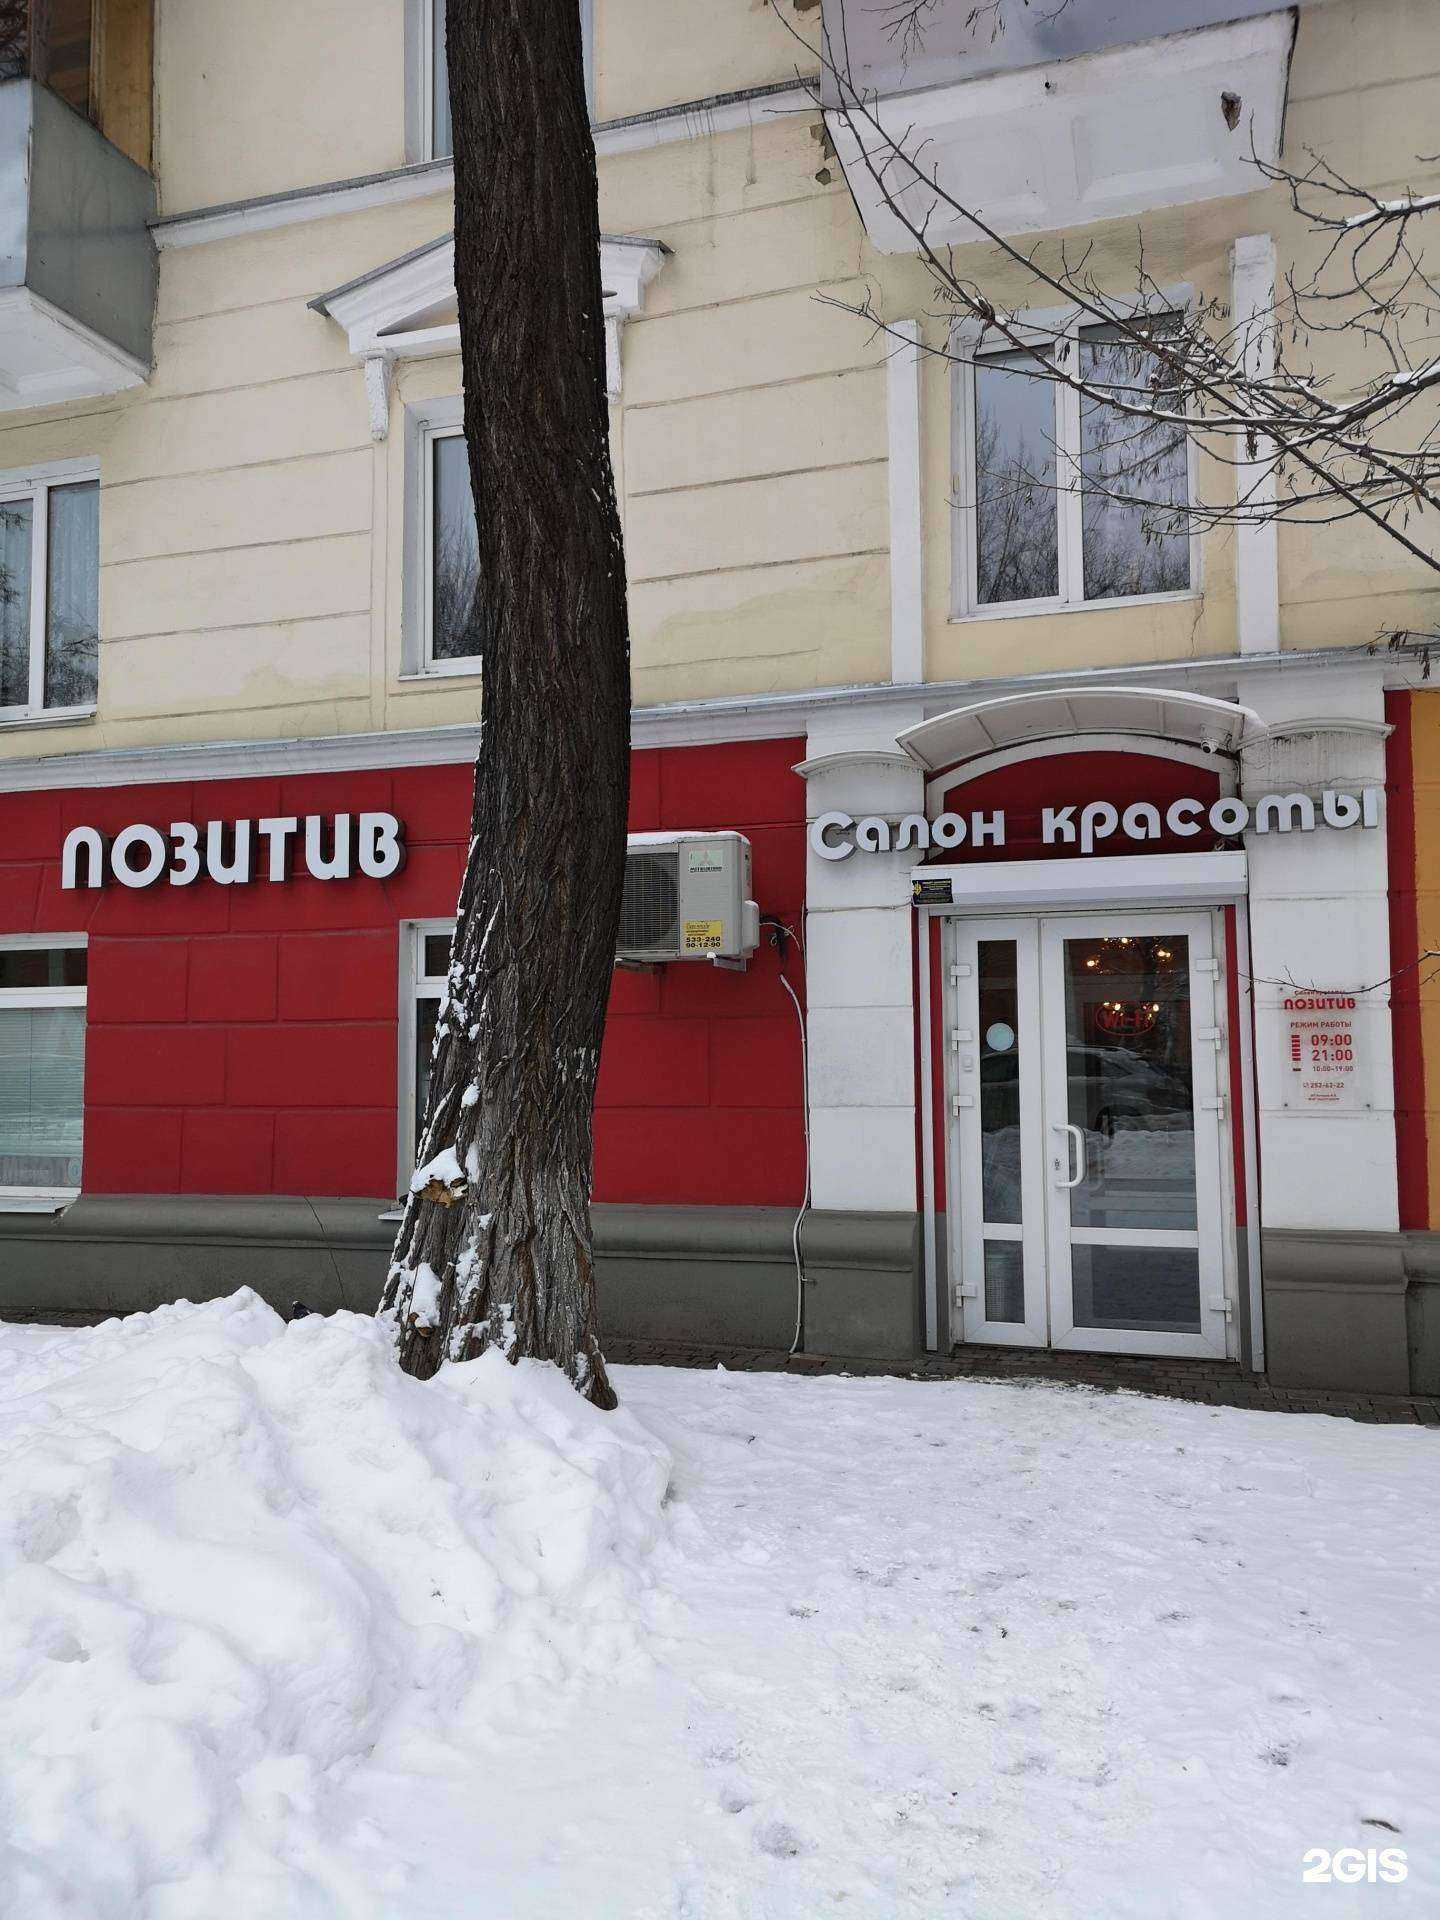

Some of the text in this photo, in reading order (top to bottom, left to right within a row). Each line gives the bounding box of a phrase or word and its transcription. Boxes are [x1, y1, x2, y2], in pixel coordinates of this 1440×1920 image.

[810, 788, 1378, 861] Салон красоты
[61, 811, 405, 890] ПОЗИТИВ
[1284, 997, 1356, 1010] ПОЗИТИВ
[1290, 1020, 1352, 1029] РЕЖИМ РАБОТЫ
[1311, 1034, 1352, 1046] 09:00
[1311, 1049, 1354, 1061] 21:00
